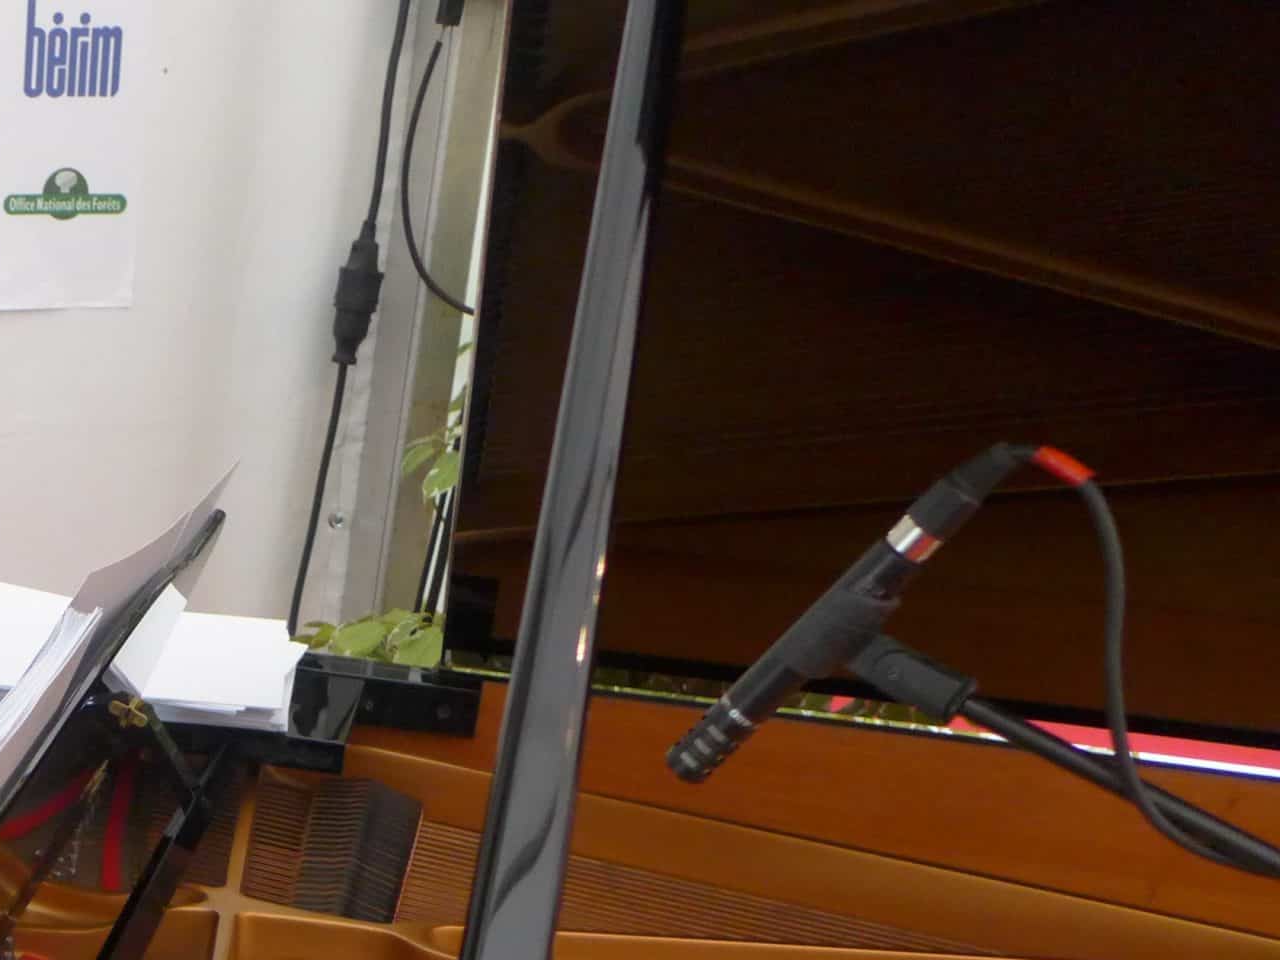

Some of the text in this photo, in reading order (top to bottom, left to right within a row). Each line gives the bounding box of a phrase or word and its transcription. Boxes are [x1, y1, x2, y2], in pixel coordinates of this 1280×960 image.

[9, 197, 35, 211] Office
[36, 198, 74, 211] National
[76, 198, 91, 210] des
